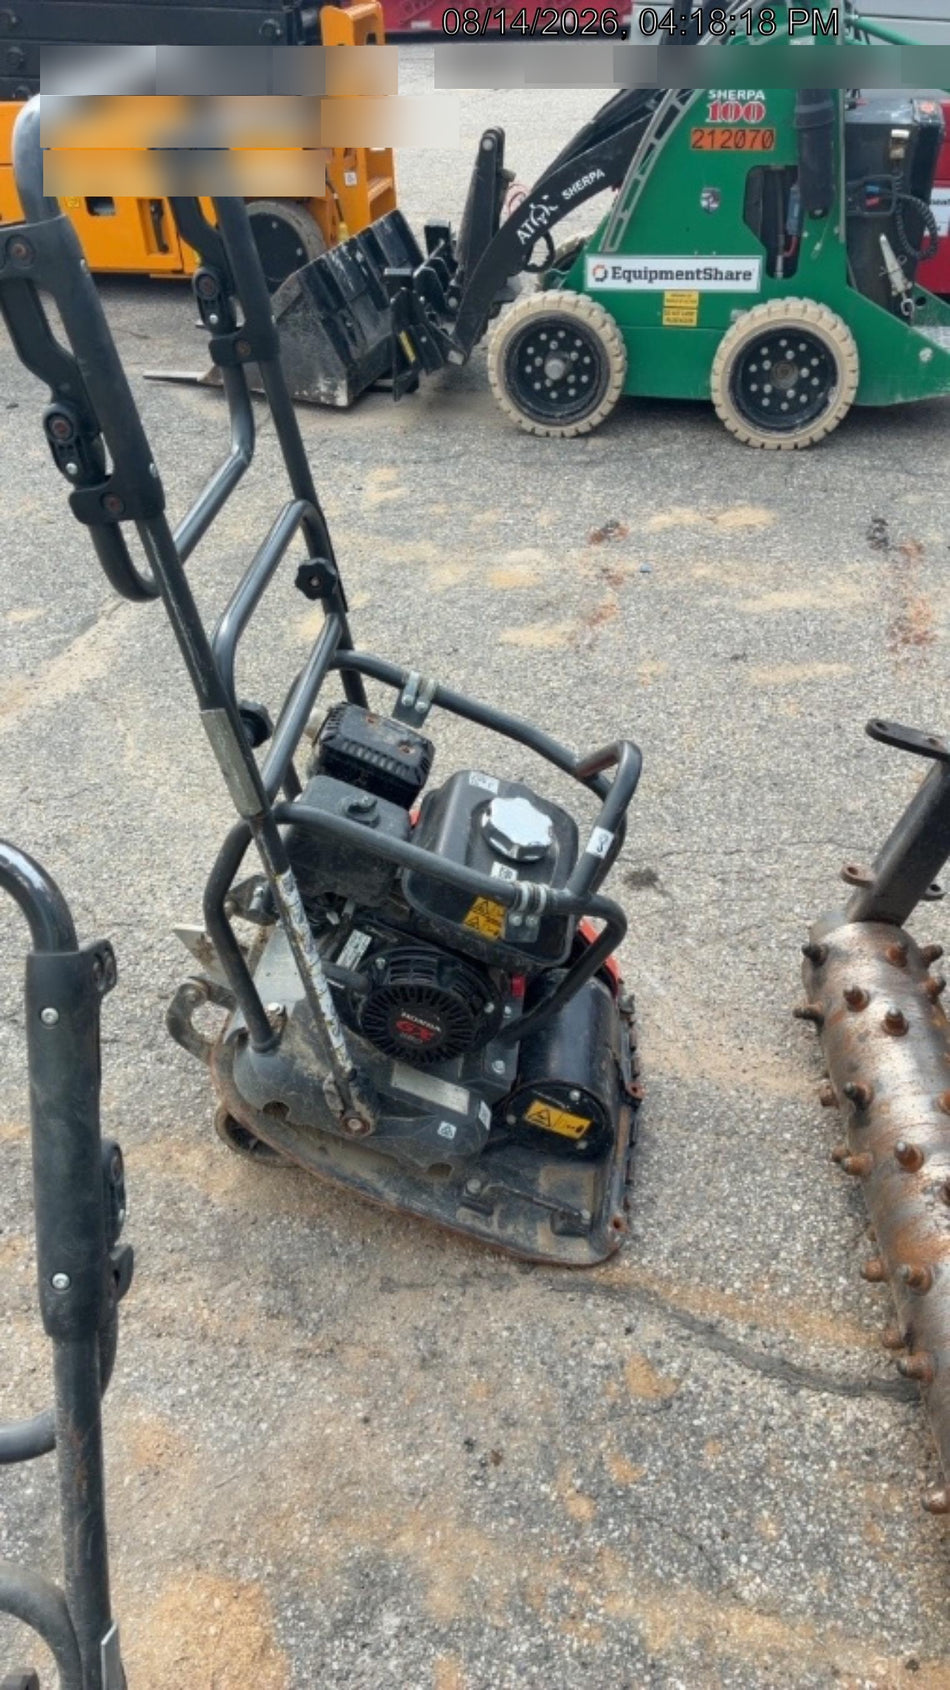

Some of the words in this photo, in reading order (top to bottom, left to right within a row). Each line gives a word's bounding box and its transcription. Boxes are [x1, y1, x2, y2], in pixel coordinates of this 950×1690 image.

[708, 89, 766, 101] SHERPA
[706, 100, 767, 123] 100
[691, 128, 775, 149] 212070
[561, 168, 605, 200] SHERPA
[611, 265, 752, 284] EquipmentShare
